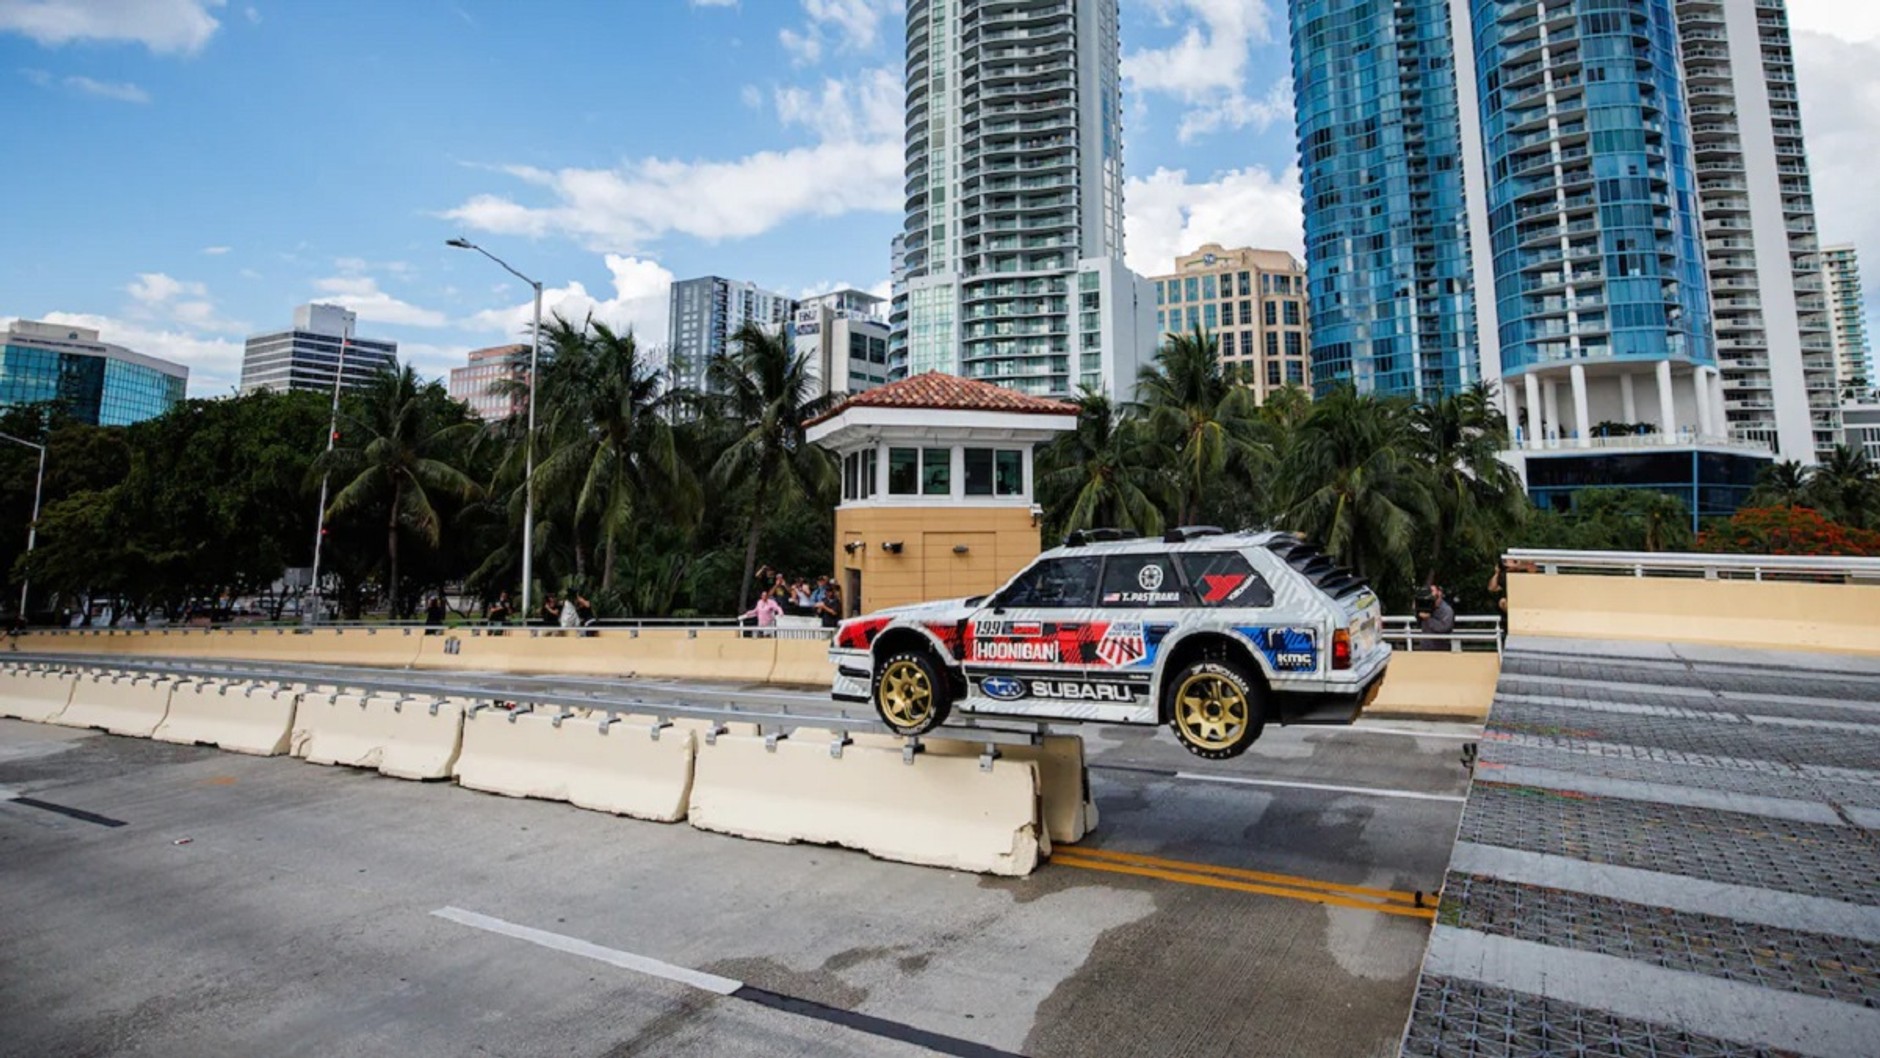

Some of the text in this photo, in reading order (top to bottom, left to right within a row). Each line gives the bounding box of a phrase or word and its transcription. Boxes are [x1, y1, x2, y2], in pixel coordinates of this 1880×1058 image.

[1131, 592, 1180, 601] PASTRANA
[976, 620, 1001, 635] 199
[1031, 681, 1132, 701] SUBARU
